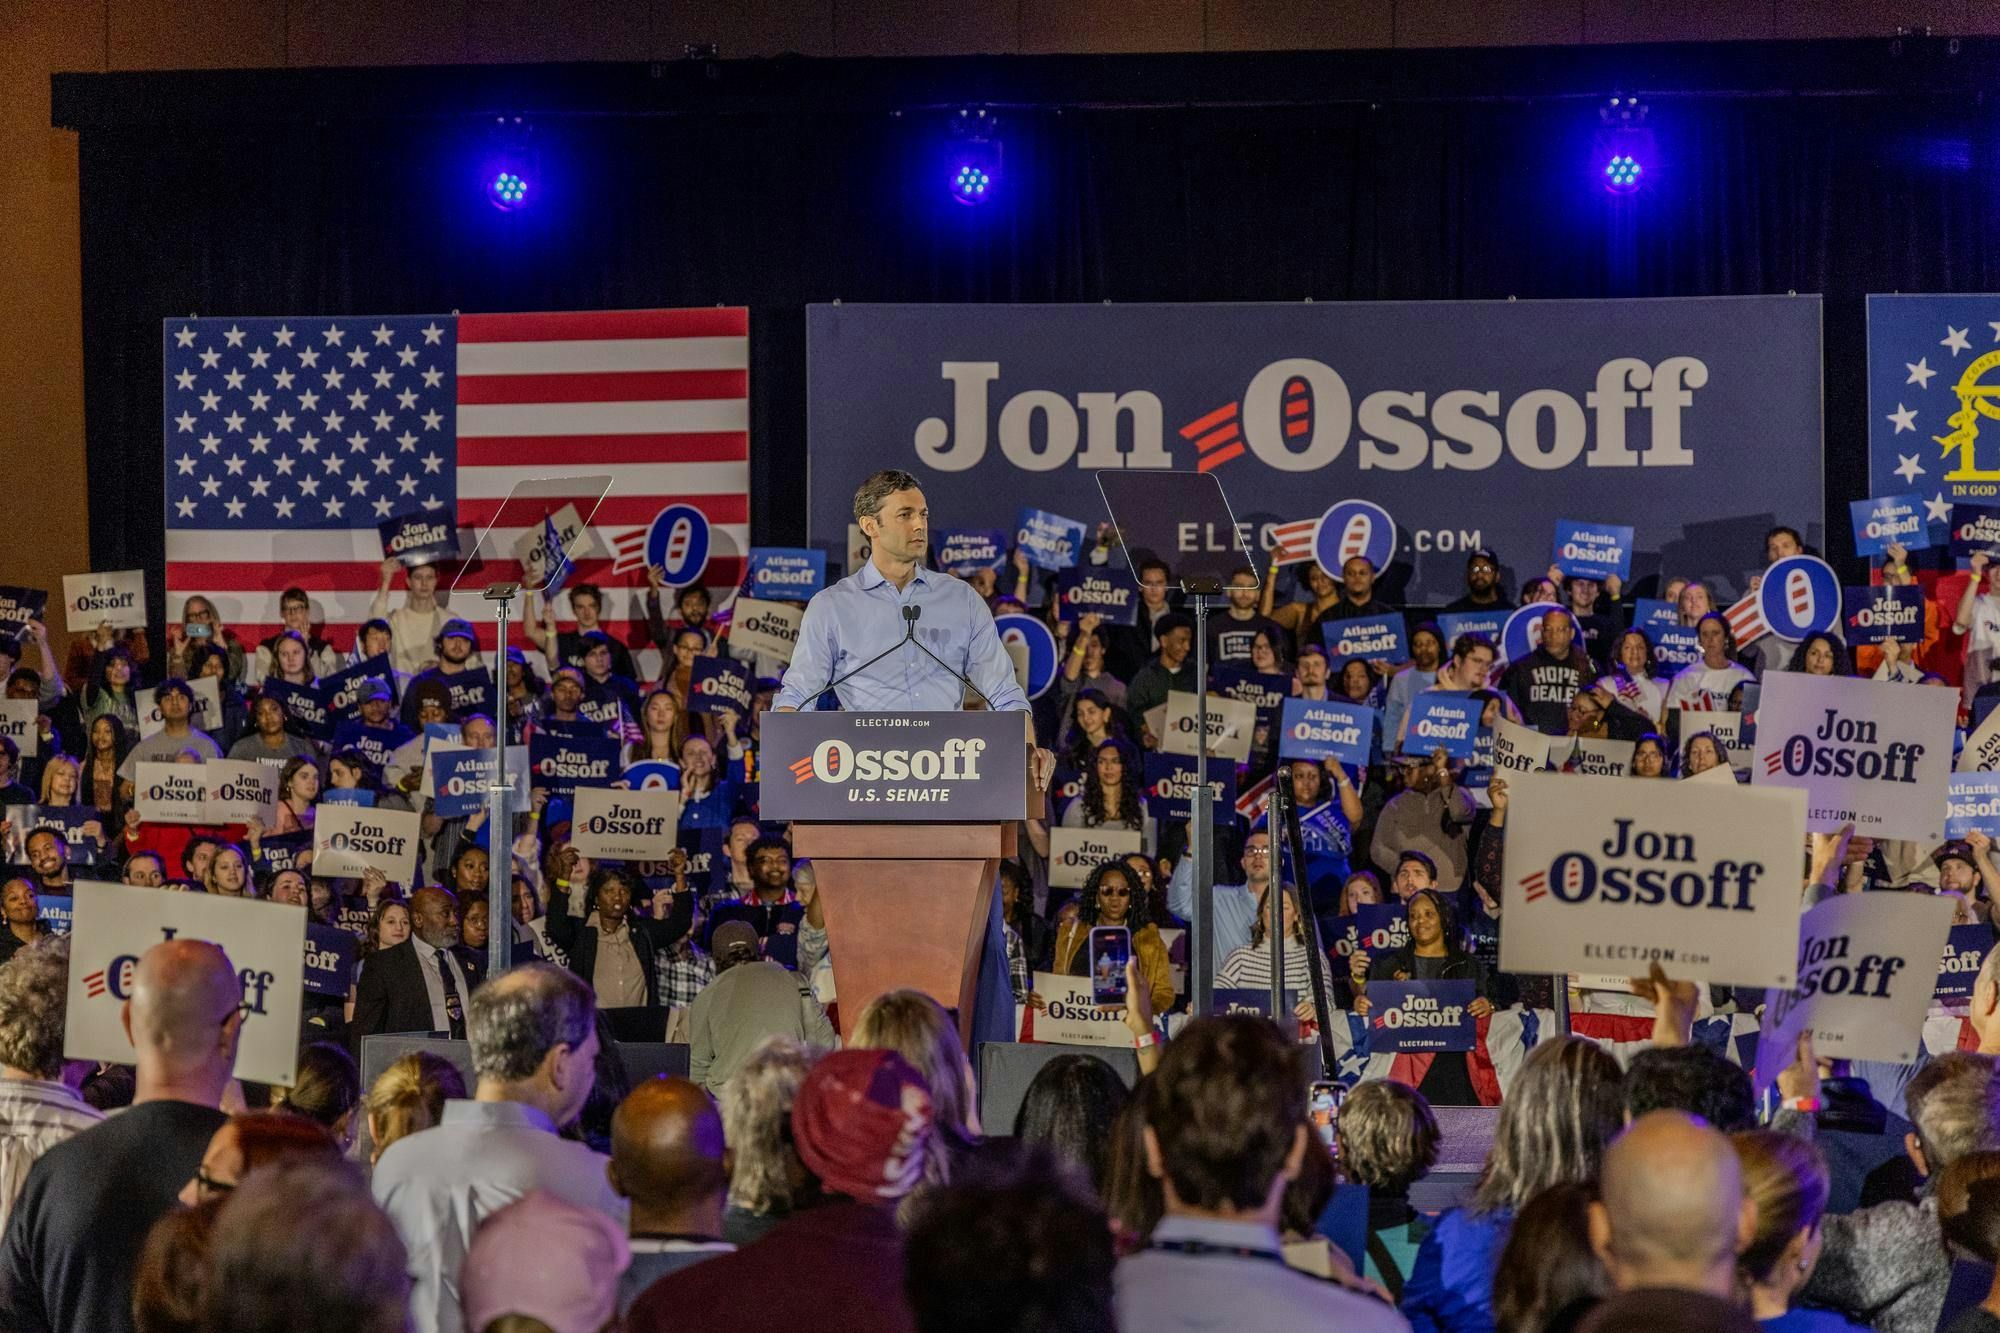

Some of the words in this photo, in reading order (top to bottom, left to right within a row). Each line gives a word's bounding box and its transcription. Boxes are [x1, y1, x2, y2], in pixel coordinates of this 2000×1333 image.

[915, 361, 1173, 472] Jon
[1242, 358, 1709, 472] Ossoff
[1952, 485, 1967, 496] IN
[1969, 485, 1997, 496] GOD
[402, 522, 429, 537] Jon
[1866, 514, 1921, 539] Ossoff
[391, 525, 448, 552] Ossoff
[944, 534, 990, 546] Atlanta
[1017, 529, 1073, 556] Ossoff
[1571, 531, 1616, 545] Atlanta
[766, 556, 809, 567] Atlanta
[941, 545, 998, 564] Ossoff
[1562, 543, 1623, 564] Ossoff
[757, 568, 816, 585] Ossoff
[1082, 577, 1110, 591] Jon
[89, 585, 116, 598] Jon
[1068, 586, 1129, 606] Ossoff
[0, 597, 16, 607] on
[77, 592, 135, 612] Ossoff
[1867, 597, 1902, 612] Jon
[761, 611, 789, 628] Jon
[1856, 605, 1919, 628] Ossoff
[745, 617, 799, 643] Ossof
[1342, 624, 1388, 638] Atlanta
[1338, 634, 1398, 656] Ossoff
[718, 669, 746, 690] Jon
[1532, 666, 1579, 686] HOPE
[1235, 680, 1264, 695] Jon
[1530, 685, 1580, 706] DEALE
[287, 692, 315, 709] Jon
[579, 700, 599, 712] on
[1304, 709, 1354, 725] Atlanta
[1427, 706, 1466, 719] Atlanta
[1294, 722, 1361, 746] Ossoff
[1417, 719, 1470, 740] Ossoff
[1817, 708, 1878, 744] Jon
[356, 736, 383, 752] Jon
[556, 748, 588, 764] Jon
[812, 737, 986, 784] Ossoff
[1782, 734, 1926, 784] Ossoff
[540, 758, 610, 778] Ossoff
[164, 775, 194, 788] Jon
[236, 773, 260, 788] Jon
[149, 785, 206, 801] Ossof
[220, 784, 273, 805] Ossoff
[847, 788, 881, 802] U.S.
[885, 788, 951, 802] SENATE
[608, 804, 642, 820] Jon
[1807, 808, 1883, 824] LECTJON.COM
[350, 821, 384, 837] Jon
[588, 816, 665, 836] Ossoff
[330, 832, 406, 856] Ossoff
[1079, 841, 1108, 855] Jon
[1602, 819, 1697, 863] Jon
[1549, 851, 1765, 912] Ossoff
[1402, 994, 1438, 1011] Jon
[1383, 1006, 1462, 1029] Ossoff
